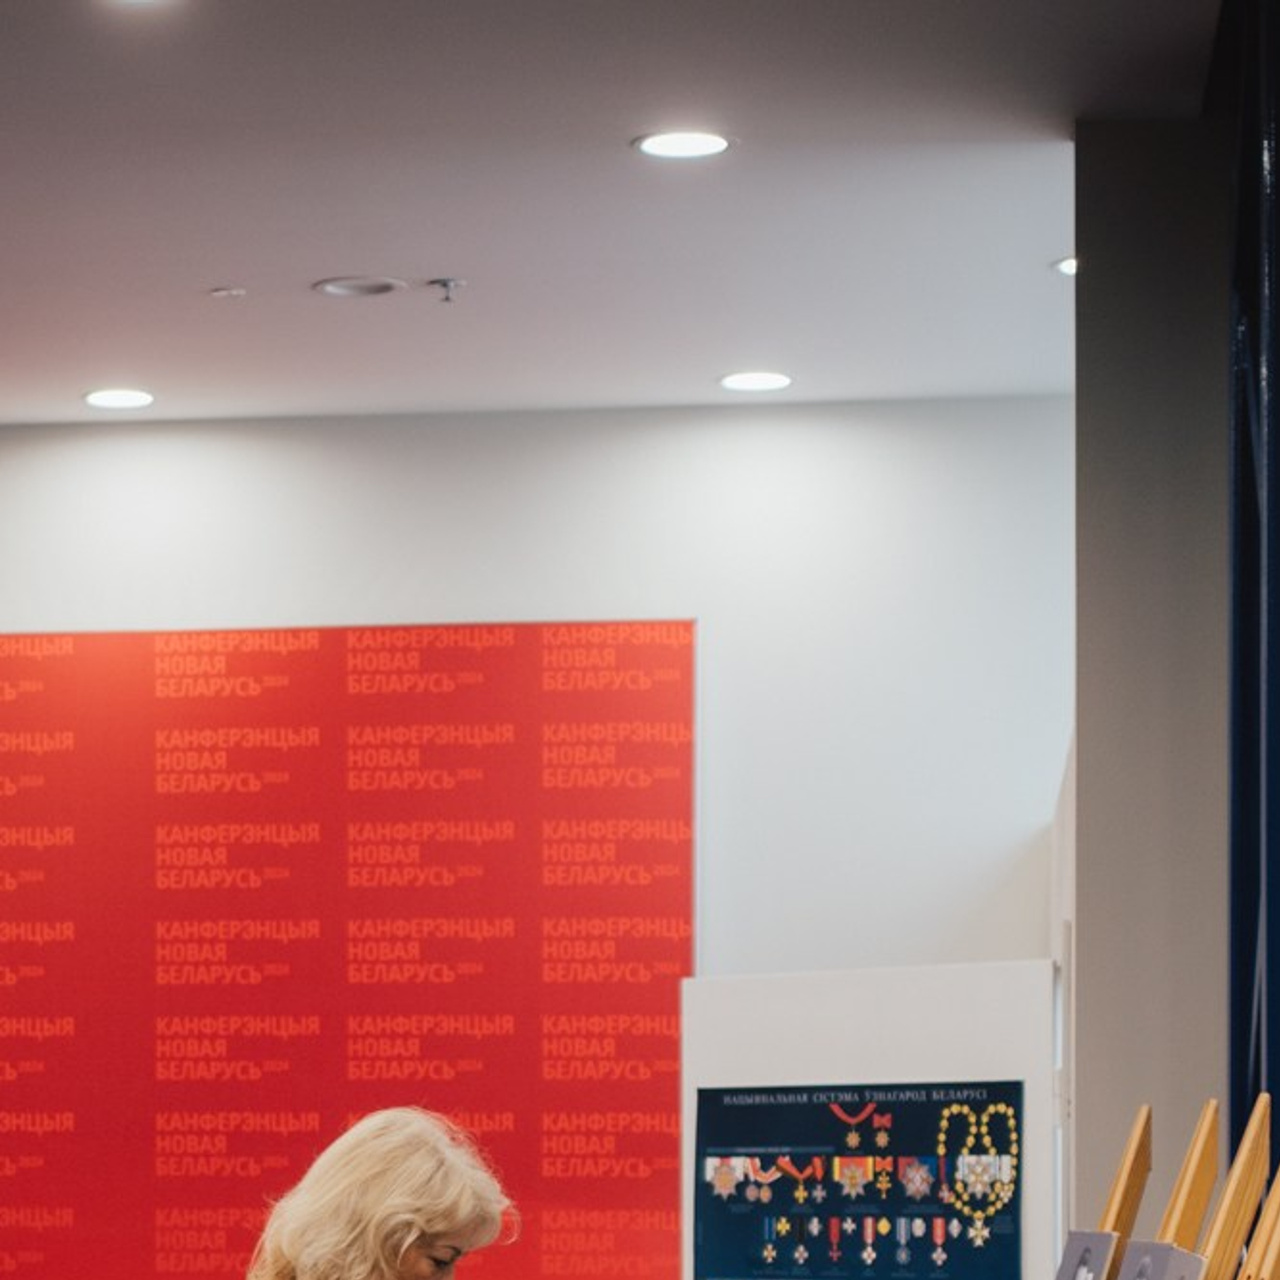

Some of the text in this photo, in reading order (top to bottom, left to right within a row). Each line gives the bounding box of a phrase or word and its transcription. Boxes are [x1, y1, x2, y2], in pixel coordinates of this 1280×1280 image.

[156, 631, 320, 654] КАНФЕРЭНЦЫЯ
[347, 627, 514, 650] КАНФЕРЭНЦЫЯ
[156, 655, 226, 675] НОВАЯ
[347, 651, 420, 671] НОВАЯ
[542, 647, 616, 667] НОВАЯ
[156, 677, 262, 697] БЕЛАРУСЬ
[347, 673, 455, 694] БЕЛАРУСЬ
[542, 670, 652, 690] БЕЛАРУСЬ
[156, 727, 320, 750] КАНФЕРЭНЦЫЯ
[347, 724, 514, 747] КАНФЕРЭНЦЫЯ
[156, 751, 226, 770] НОВАЯ
[347, 748, 420, 767] НОВАЯ
[542, 745, 616, 764] НОВАЯ
[156, 773, 262, 793] БЕЛАРУСЬ
[347, 770, 455, 790] БЕЛАРУСЬ
[542, 767, 652, 787] БЕЛАРУСЬ
[156, 823, 320, 846] КАНФЕРЭНЦЫЯ
[347, 821, 514, 844] КАНФЕРЭНЦЫЯ
[156, 846, 226, 866] НОВАЯ
[347, 844, 420, 864] НОВАЯ
[542, 842, 616, 861] НОВАЯ
[156, 869, 262, 888] БЕЛАРУСЬ
[347, 866, 455, 886] БЕЛАРУСЬ
[542, 864, 652, 884] БЕЛАРУСЬ
[156, 919, 320, 942] КАНФЕРЭНЦЫЯ
[347, 918, 514, 941] КАНФЕРЭНЦЫЯ
[156, 942, 226, 962] НОВАЯ
[347, 941, 420, 960] НОВАЯ
[542, 940, 616, 959] НОВАЯ
[156, 965, 262, 984] БЕЛАРУСЬ
[347, 963, 455, 983] БЕЛАРУСЬ
[542, 962, 652, 981] БЕЛАРУСЬ
[156, 1016, 320, 1039] КАНФЕРЭНЦЫЯ
[347, 1015, 514, 1038] КАНФЕРЭНЦЫЯ
[156, 1038, 226, 1057] НОВАЯ
[347, 1038, 420, 1057] НОВАЯ
[542, 1037, 616, 1056] НОВАЯ
[156, 1061, 262, 1080] БЕЛАРУСЬ
[347, 1060, 455, 1079] БЕЛАРУСЬ
[542, 1060, 652, 1079] БЕЛАРУСЬ
[156, 1112, 320, 1135] КАНФЕРЭНЦЫЯ
[156, 1134, 226, 1153] НОВАЯ
[542, 1135, 616, 1154] НОВАЯ
[156, 1157, 262, 1176] БЕЛАРУСЬ
[542, 1158, 652, 1177] БЕЛАРУСЬ
